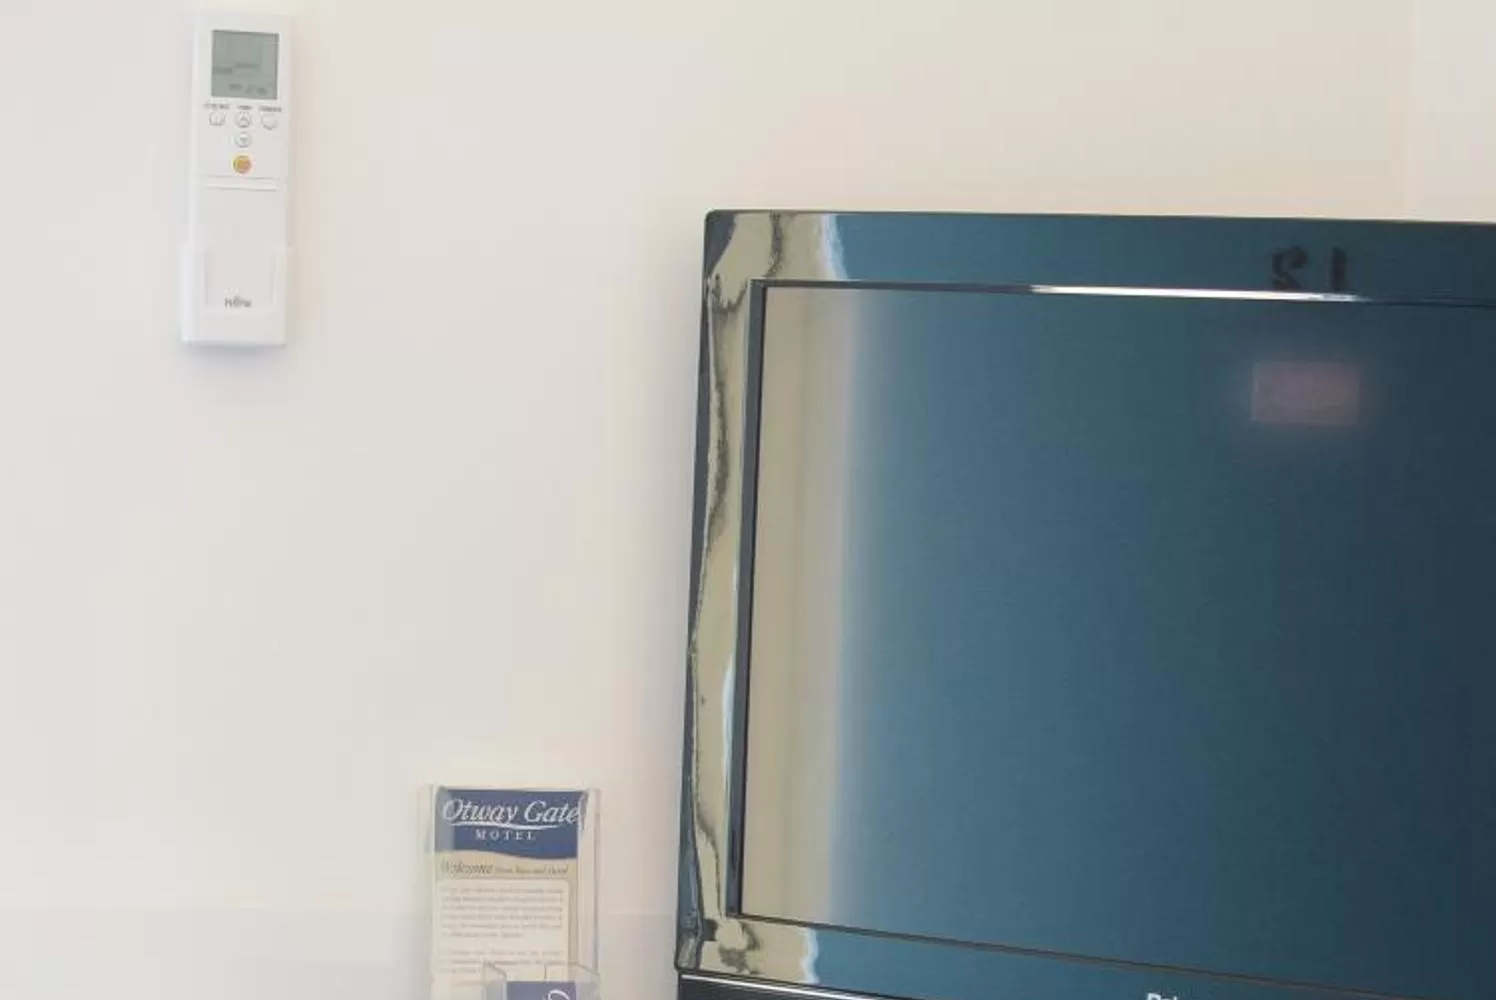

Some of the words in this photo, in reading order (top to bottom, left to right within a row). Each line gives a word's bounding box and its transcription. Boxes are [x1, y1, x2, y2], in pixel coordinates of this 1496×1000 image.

[442, 798, 518, 824] Otway
[523, 800, 581, 824] Gate
[474, 828, 536, 841] MOTEL
